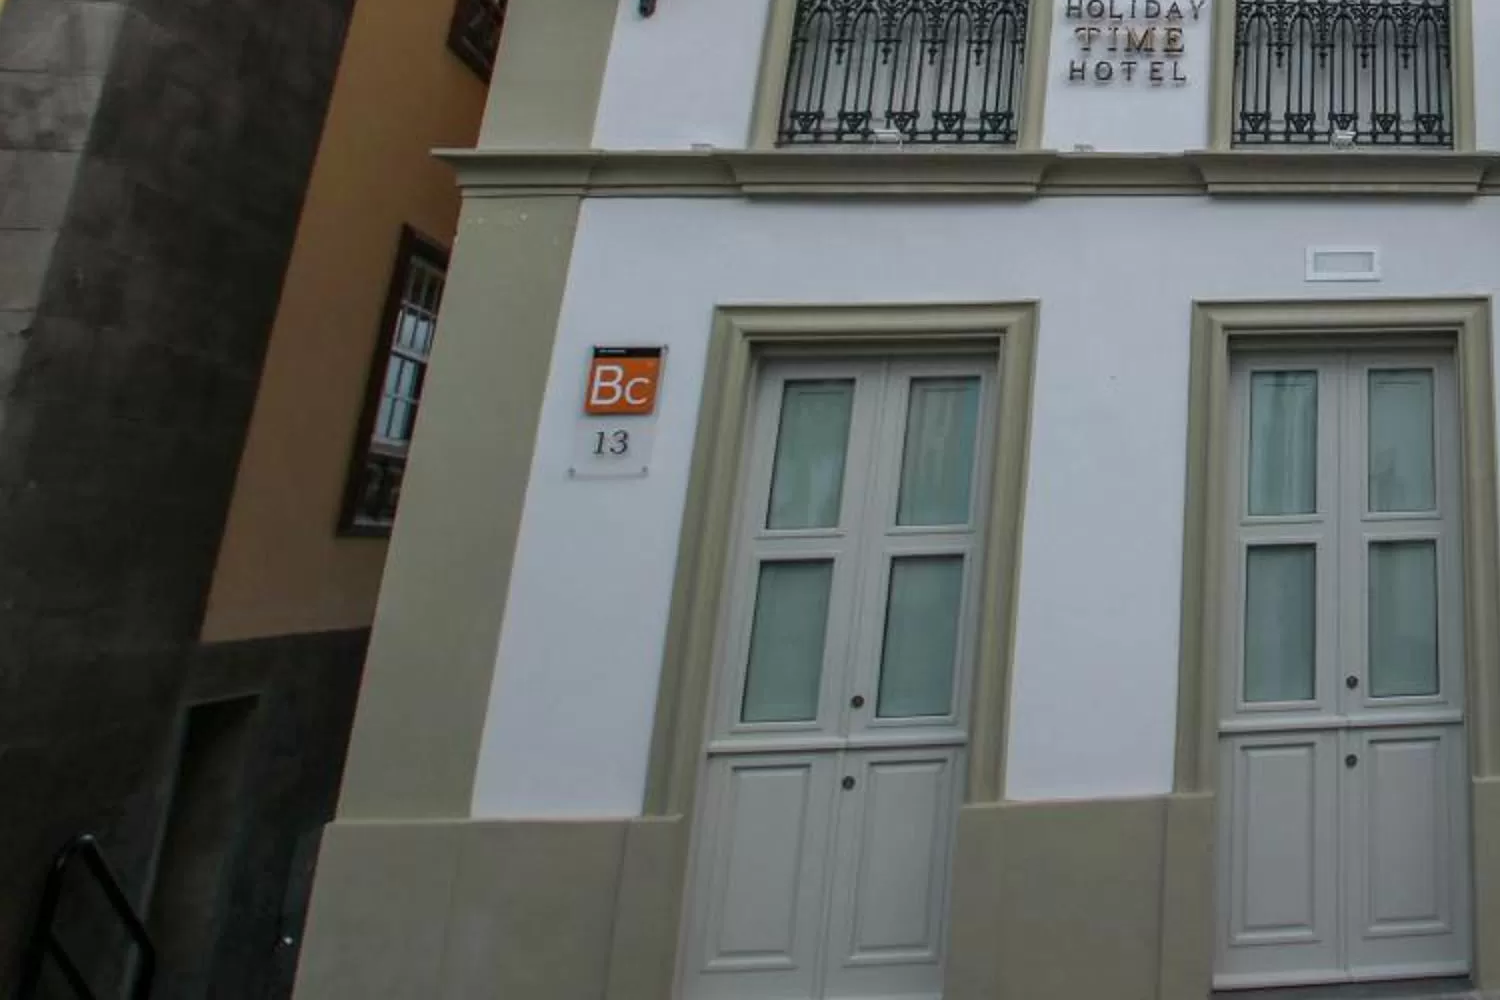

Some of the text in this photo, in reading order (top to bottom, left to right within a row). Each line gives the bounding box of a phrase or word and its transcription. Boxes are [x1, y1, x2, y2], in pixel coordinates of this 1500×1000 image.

[1075, 27, 1185, 52] TIME
[1069, 60, 1187, 81] HOTEL
[590, 365, 649, 405] Bc
[593, 430, 629, 455] 13
